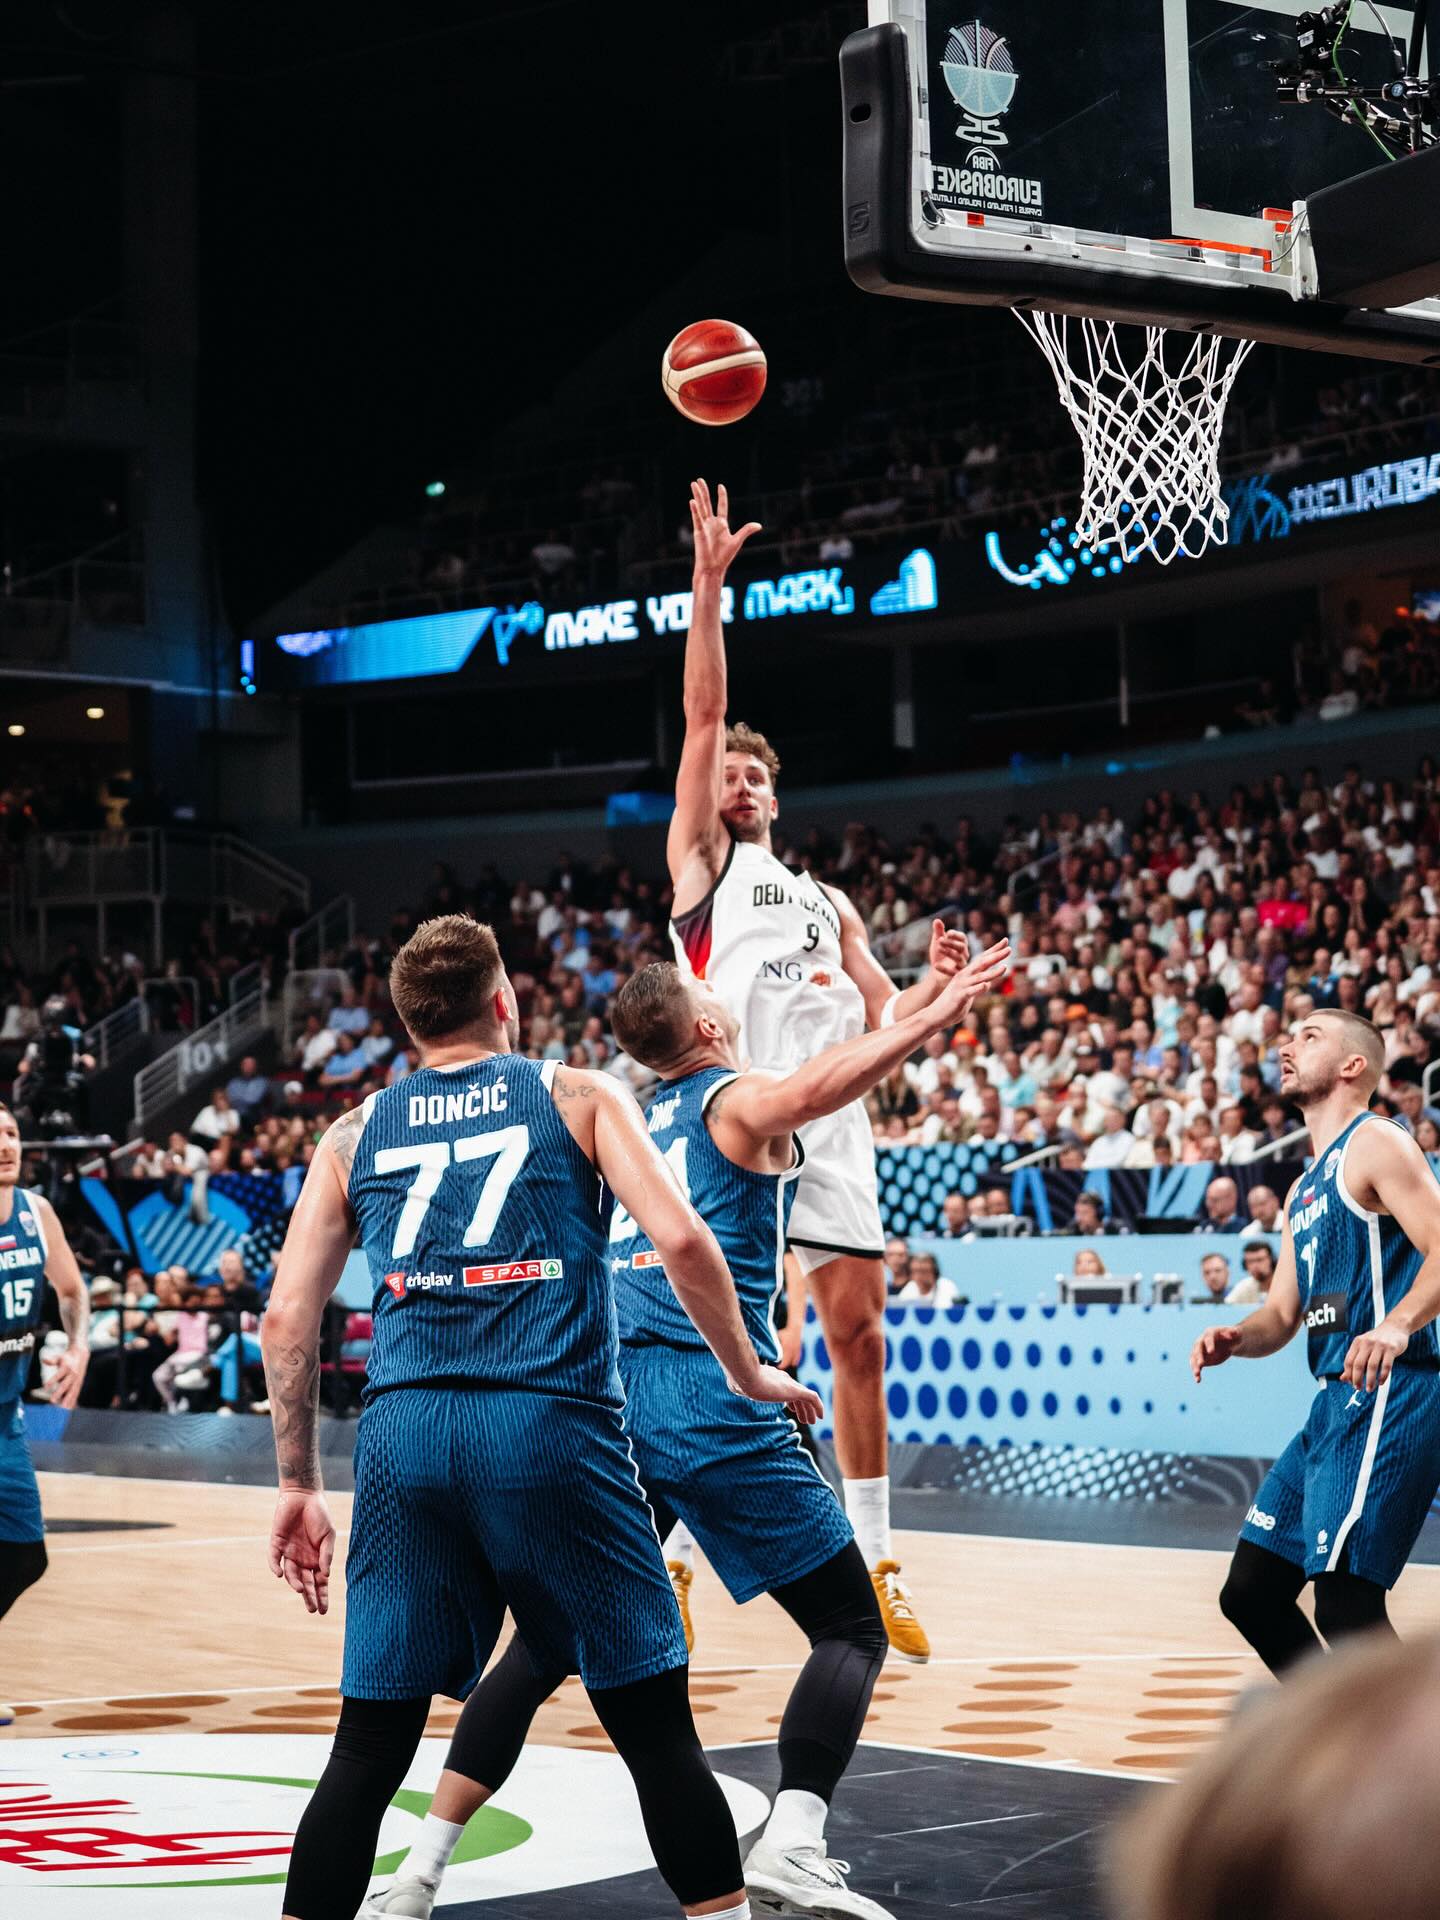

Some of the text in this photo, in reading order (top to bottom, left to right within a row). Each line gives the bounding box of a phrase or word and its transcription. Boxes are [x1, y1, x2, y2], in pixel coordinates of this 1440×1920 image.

[545, 600, 639, 650] MAKE
[646, 587, 735, 635] YOR
[803, 922, 820, 953] 9
[409, 1076, 508, 1128] DONČIĆ
[374, 1124, 530, 1260] 77
[1, 1277, 36, 1321] 15
[406, 1264, 541, 1290] triglav SPAR
